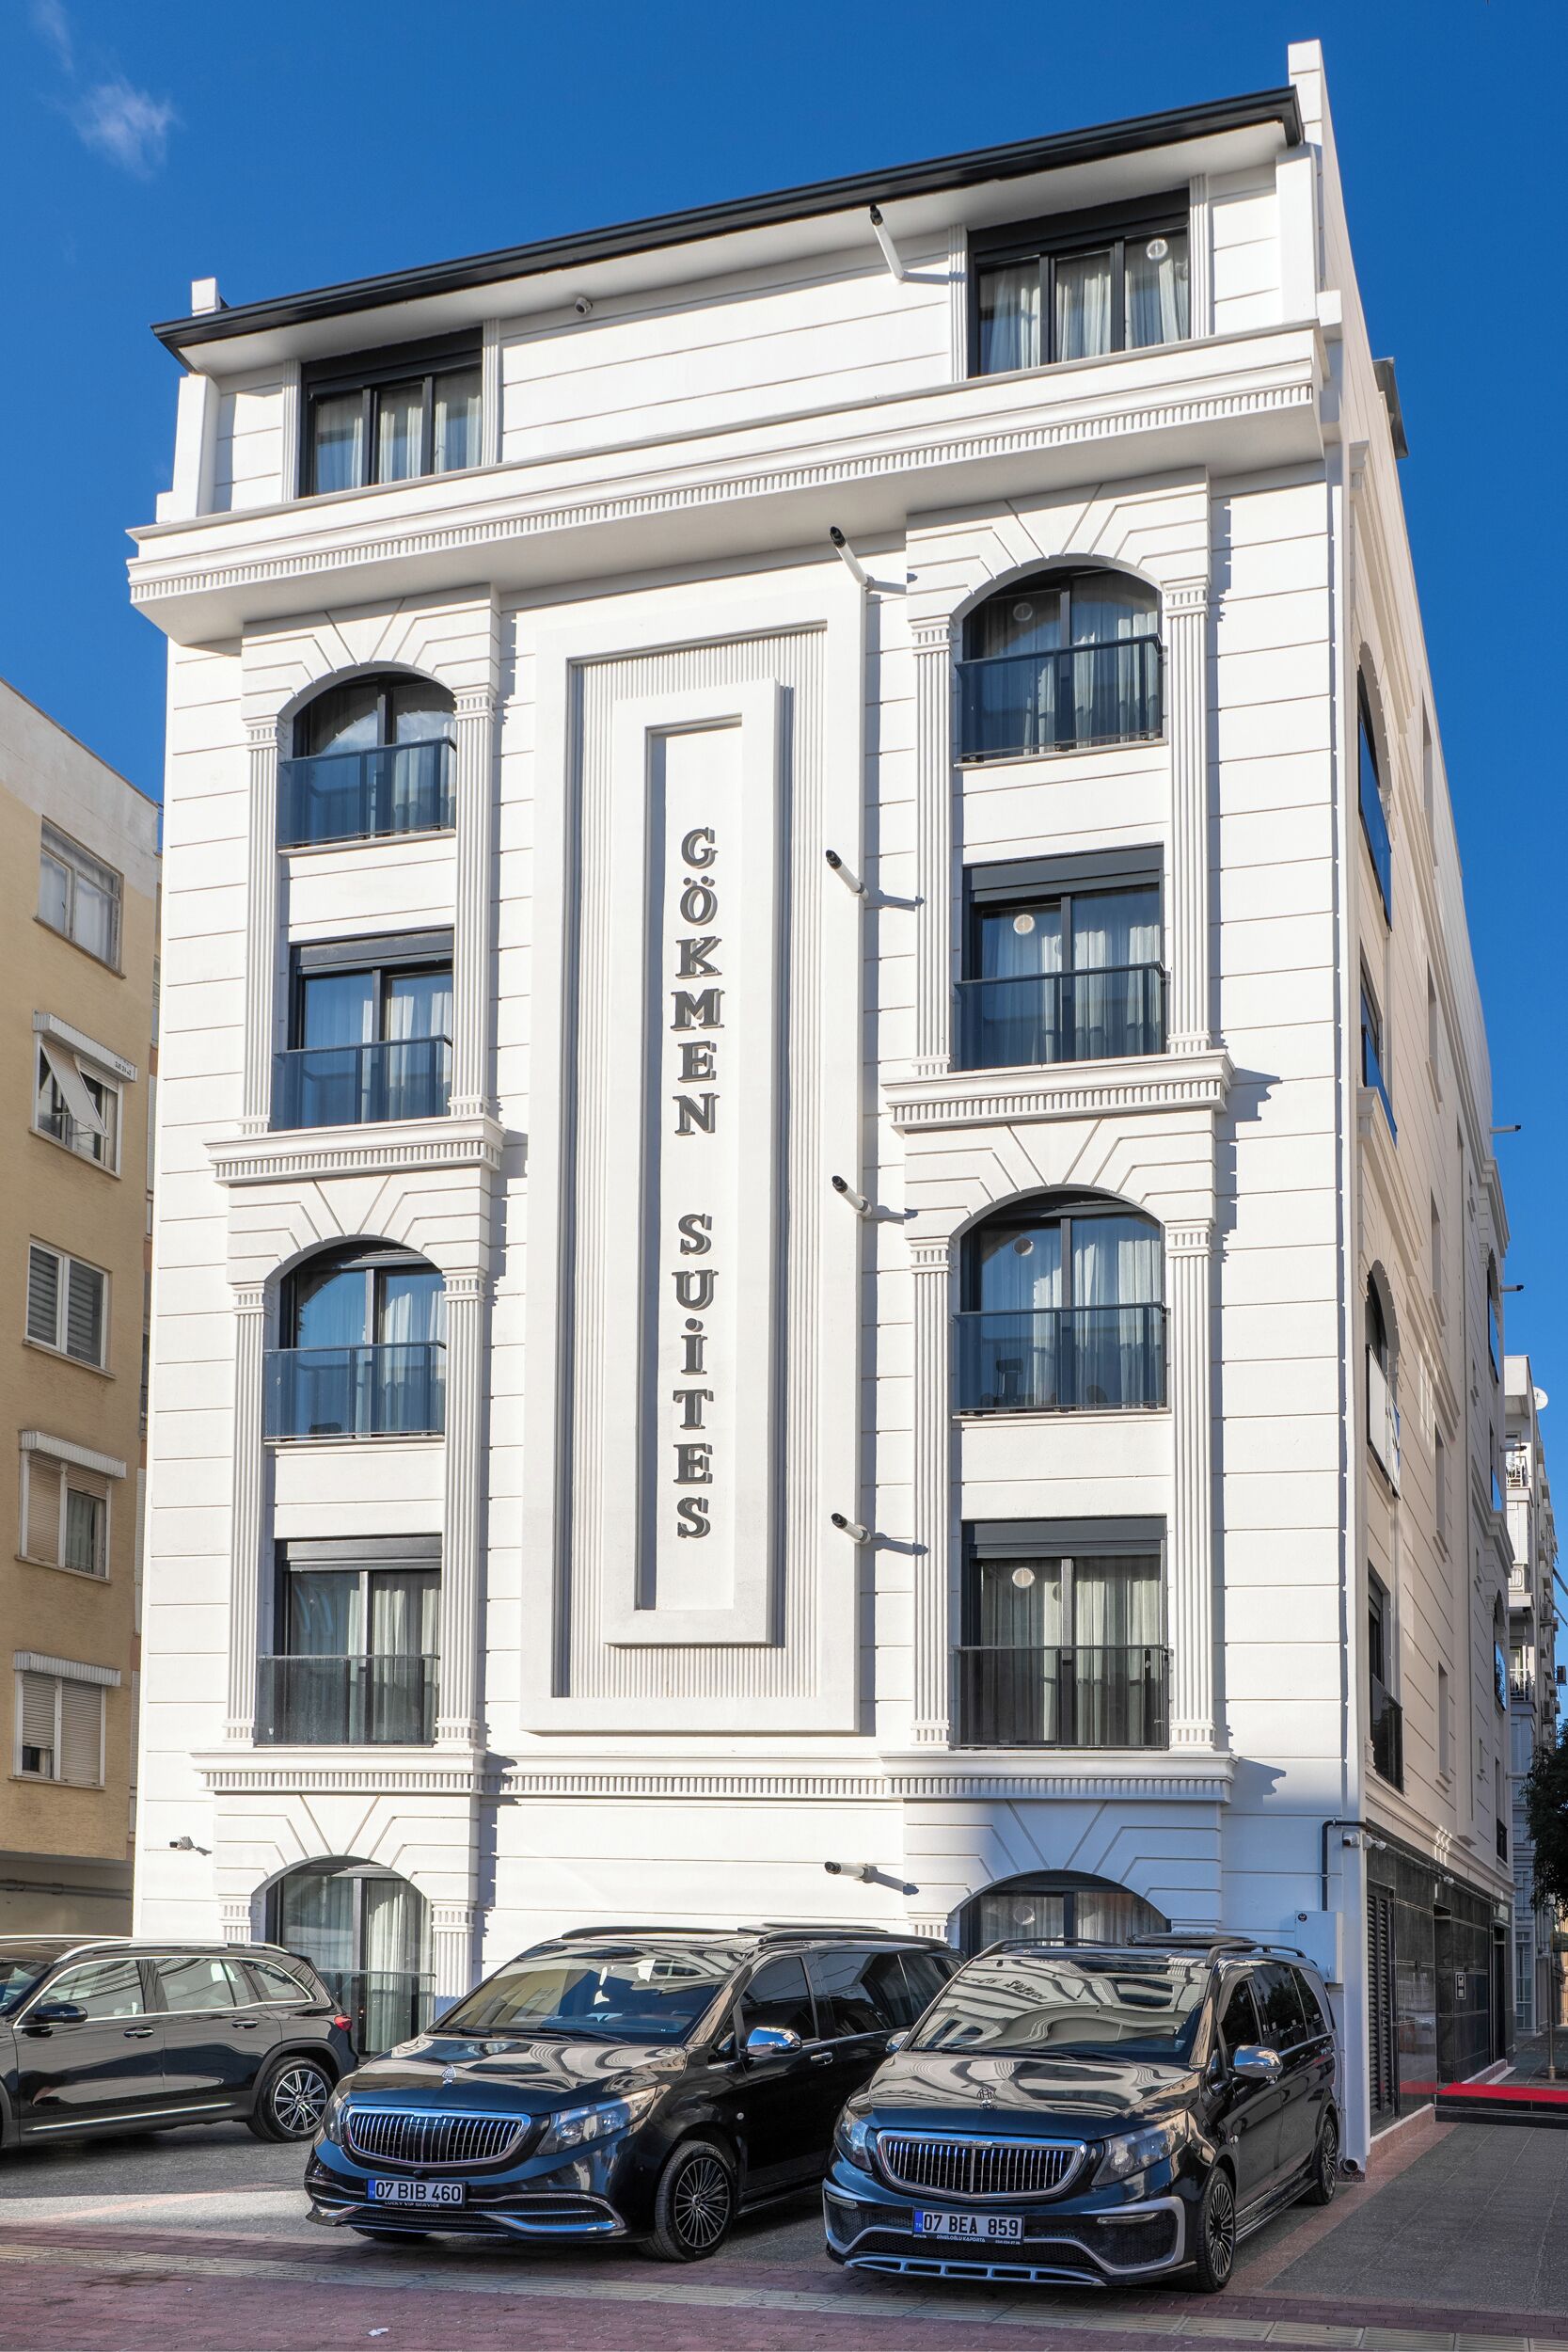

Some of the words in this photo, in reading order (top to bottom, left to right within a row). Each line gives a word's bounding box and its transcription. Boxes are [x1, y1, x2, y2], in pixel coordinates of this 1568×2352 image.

[670, 827, 725, 1136] GÖKMEN
[376, 2182, 395, 2198] 07
[398, 2183, 427, 2200] BIB
[431, 2185, 461, 2201] 460
[924, 2214, 942, 2232] 07
[948, 2216, 978, 2234] BEA
[988, 2217, 1019, 2237] 859
